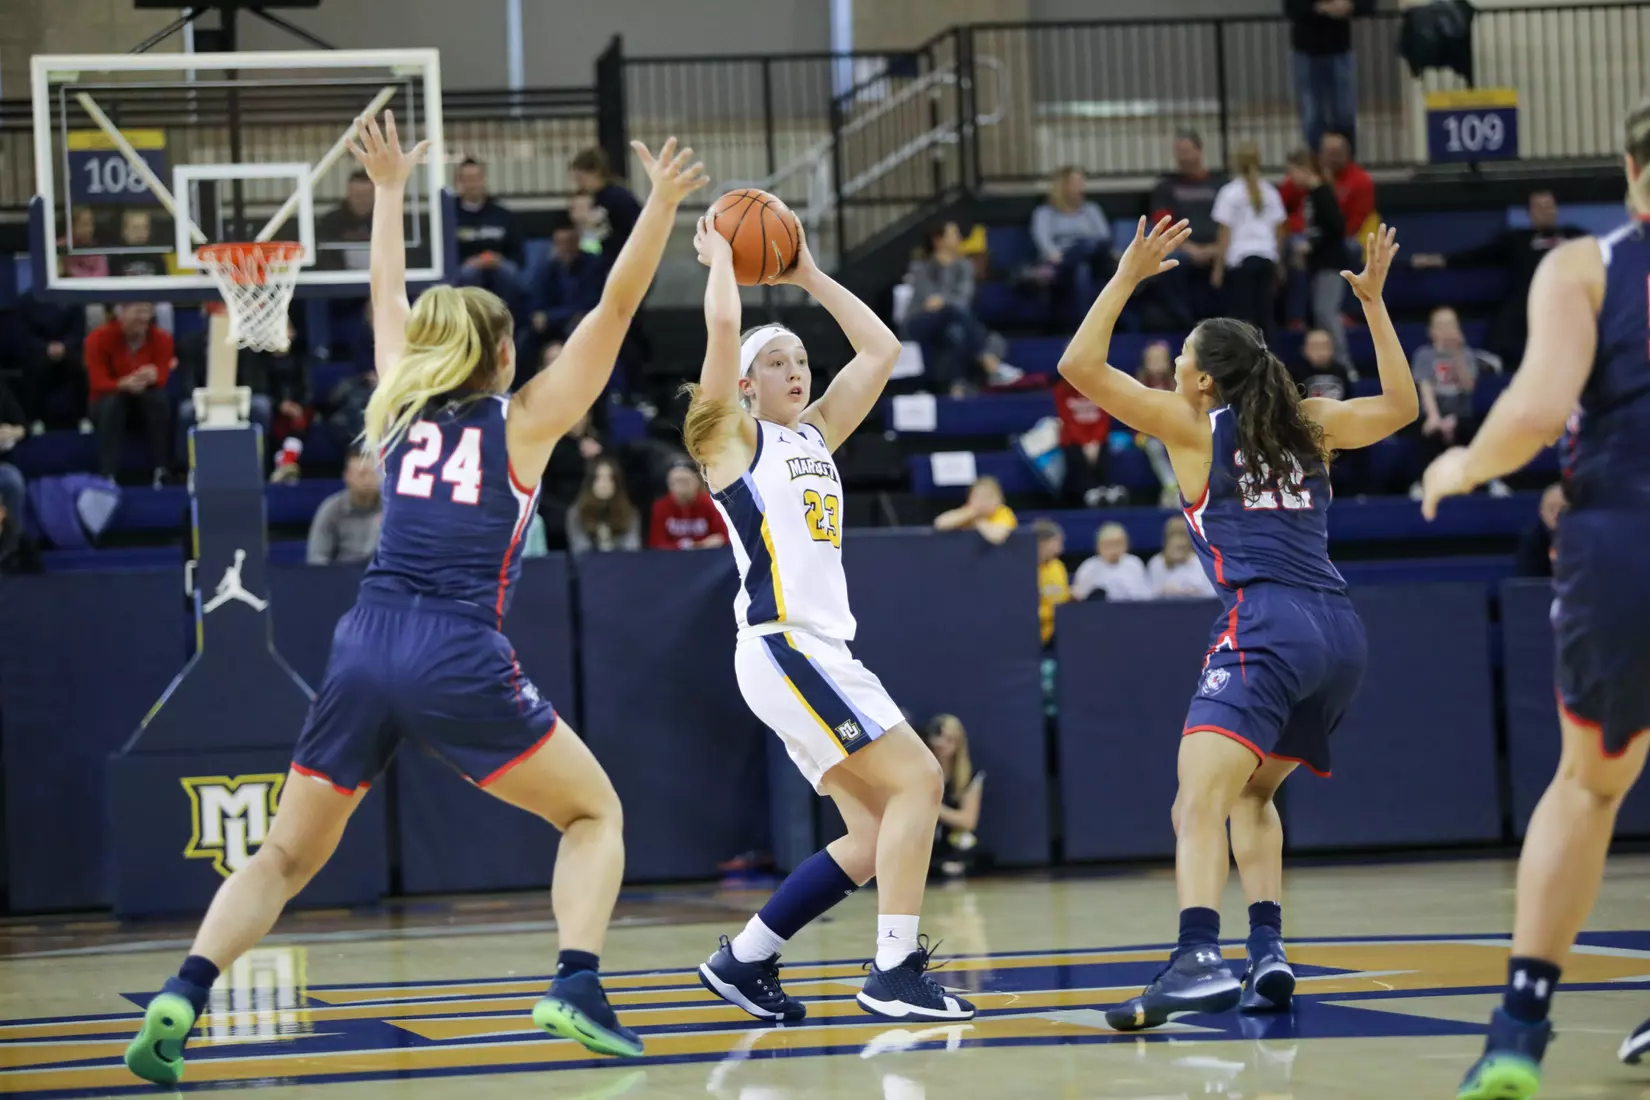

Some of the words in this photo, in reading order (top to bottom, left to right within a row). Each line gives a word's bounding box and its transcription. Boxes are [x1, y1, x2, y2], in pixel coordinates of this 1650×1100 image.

[1442, 113, 1505, 152] 109
[396, 419, 483, 506] 24
[803, 489, 841, 549] 23
